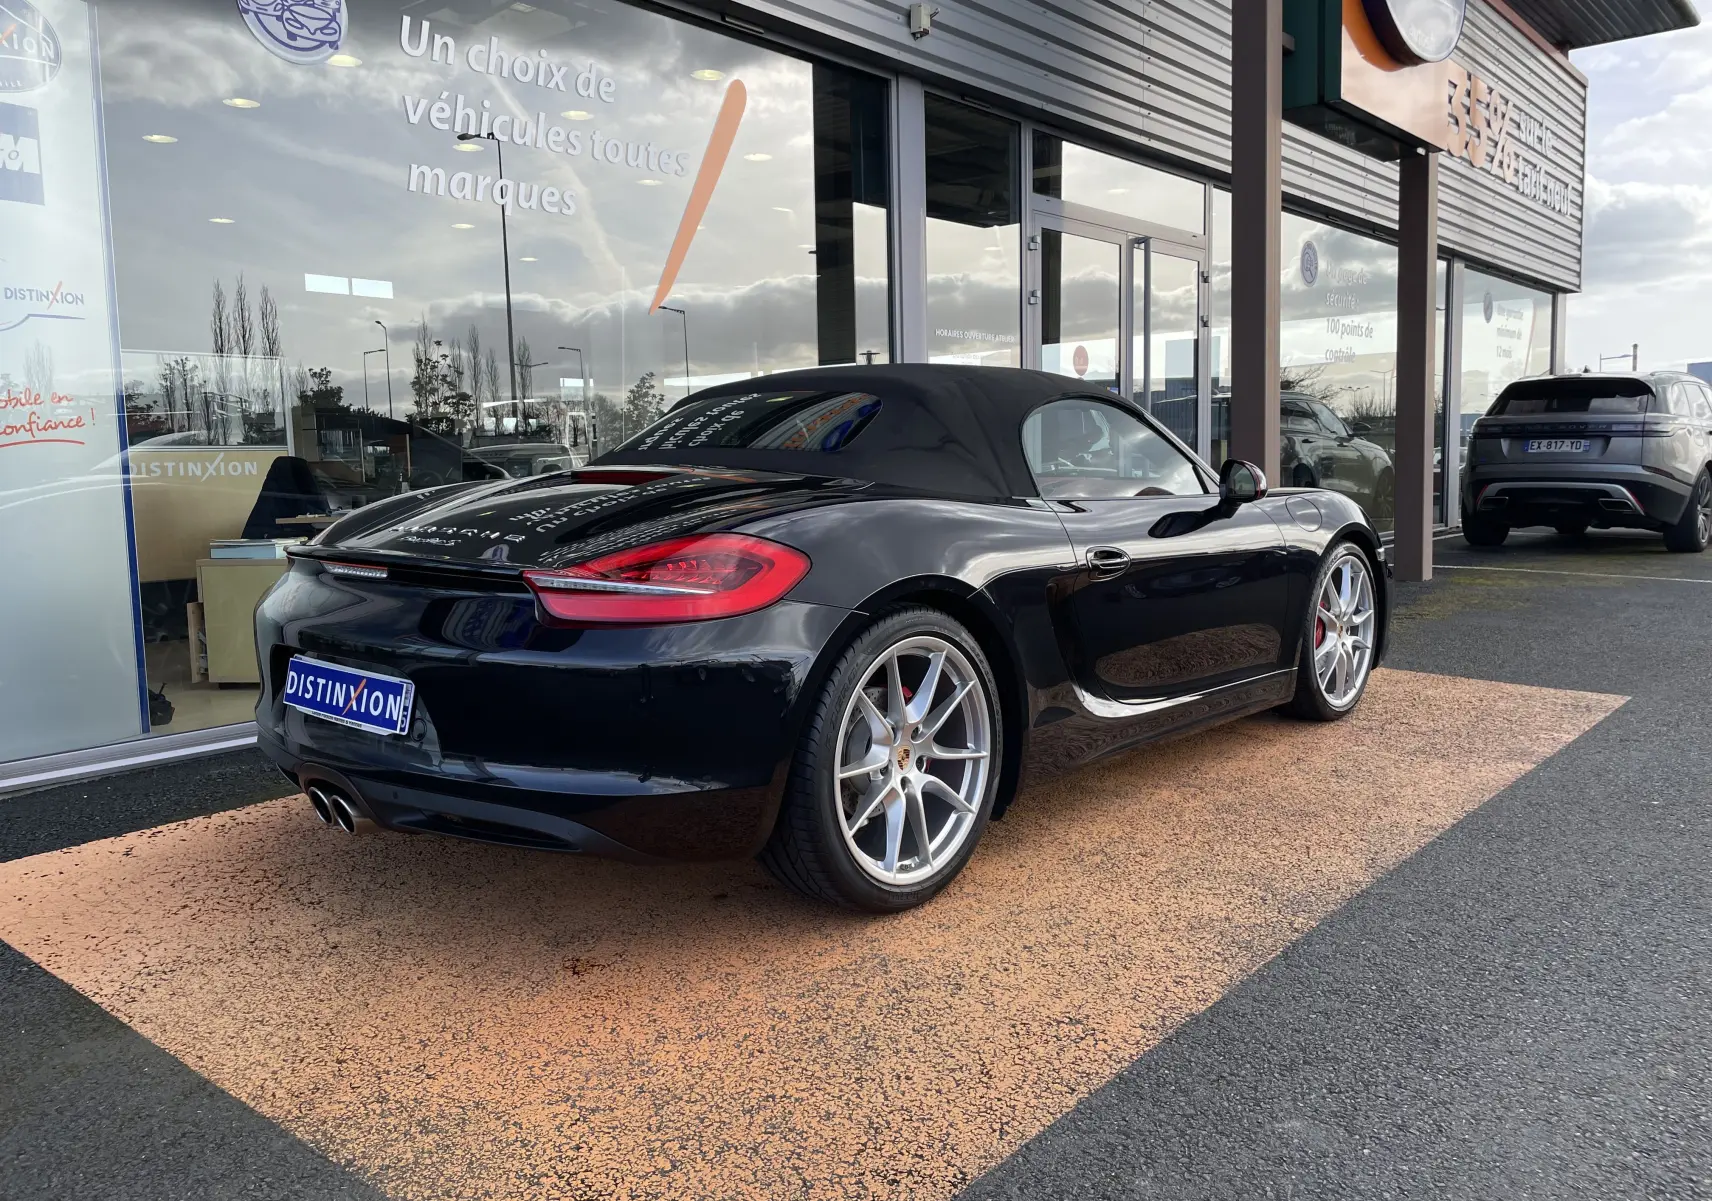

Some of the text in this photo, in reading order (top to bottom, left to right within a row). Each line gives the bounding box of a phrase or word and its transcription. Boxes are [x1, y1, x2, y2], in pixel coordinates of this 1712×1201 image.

[399, 15, 616, 103] Un choix de
[403, 91, 692, 178] véhicules toutes
[407, 163, 577, 217] marques
[4, 281, 84, 309] DISTINXION
[935, 328, 963, 339] HORAIRES
[964, 331, 995, 342] OUVERTURE
[1326, 318, 1374, 340] 100 points de
[1325, 347, 1356, 363] contrôle
[51, 391, 73, 404] en
[0, 411, 85, 438] onfiance
[1530, 440, 1582, 451] EX-817-YD
[130, 452, 258, 482] DISTINXION
[286, 671, 400, 721] DISTINXION
